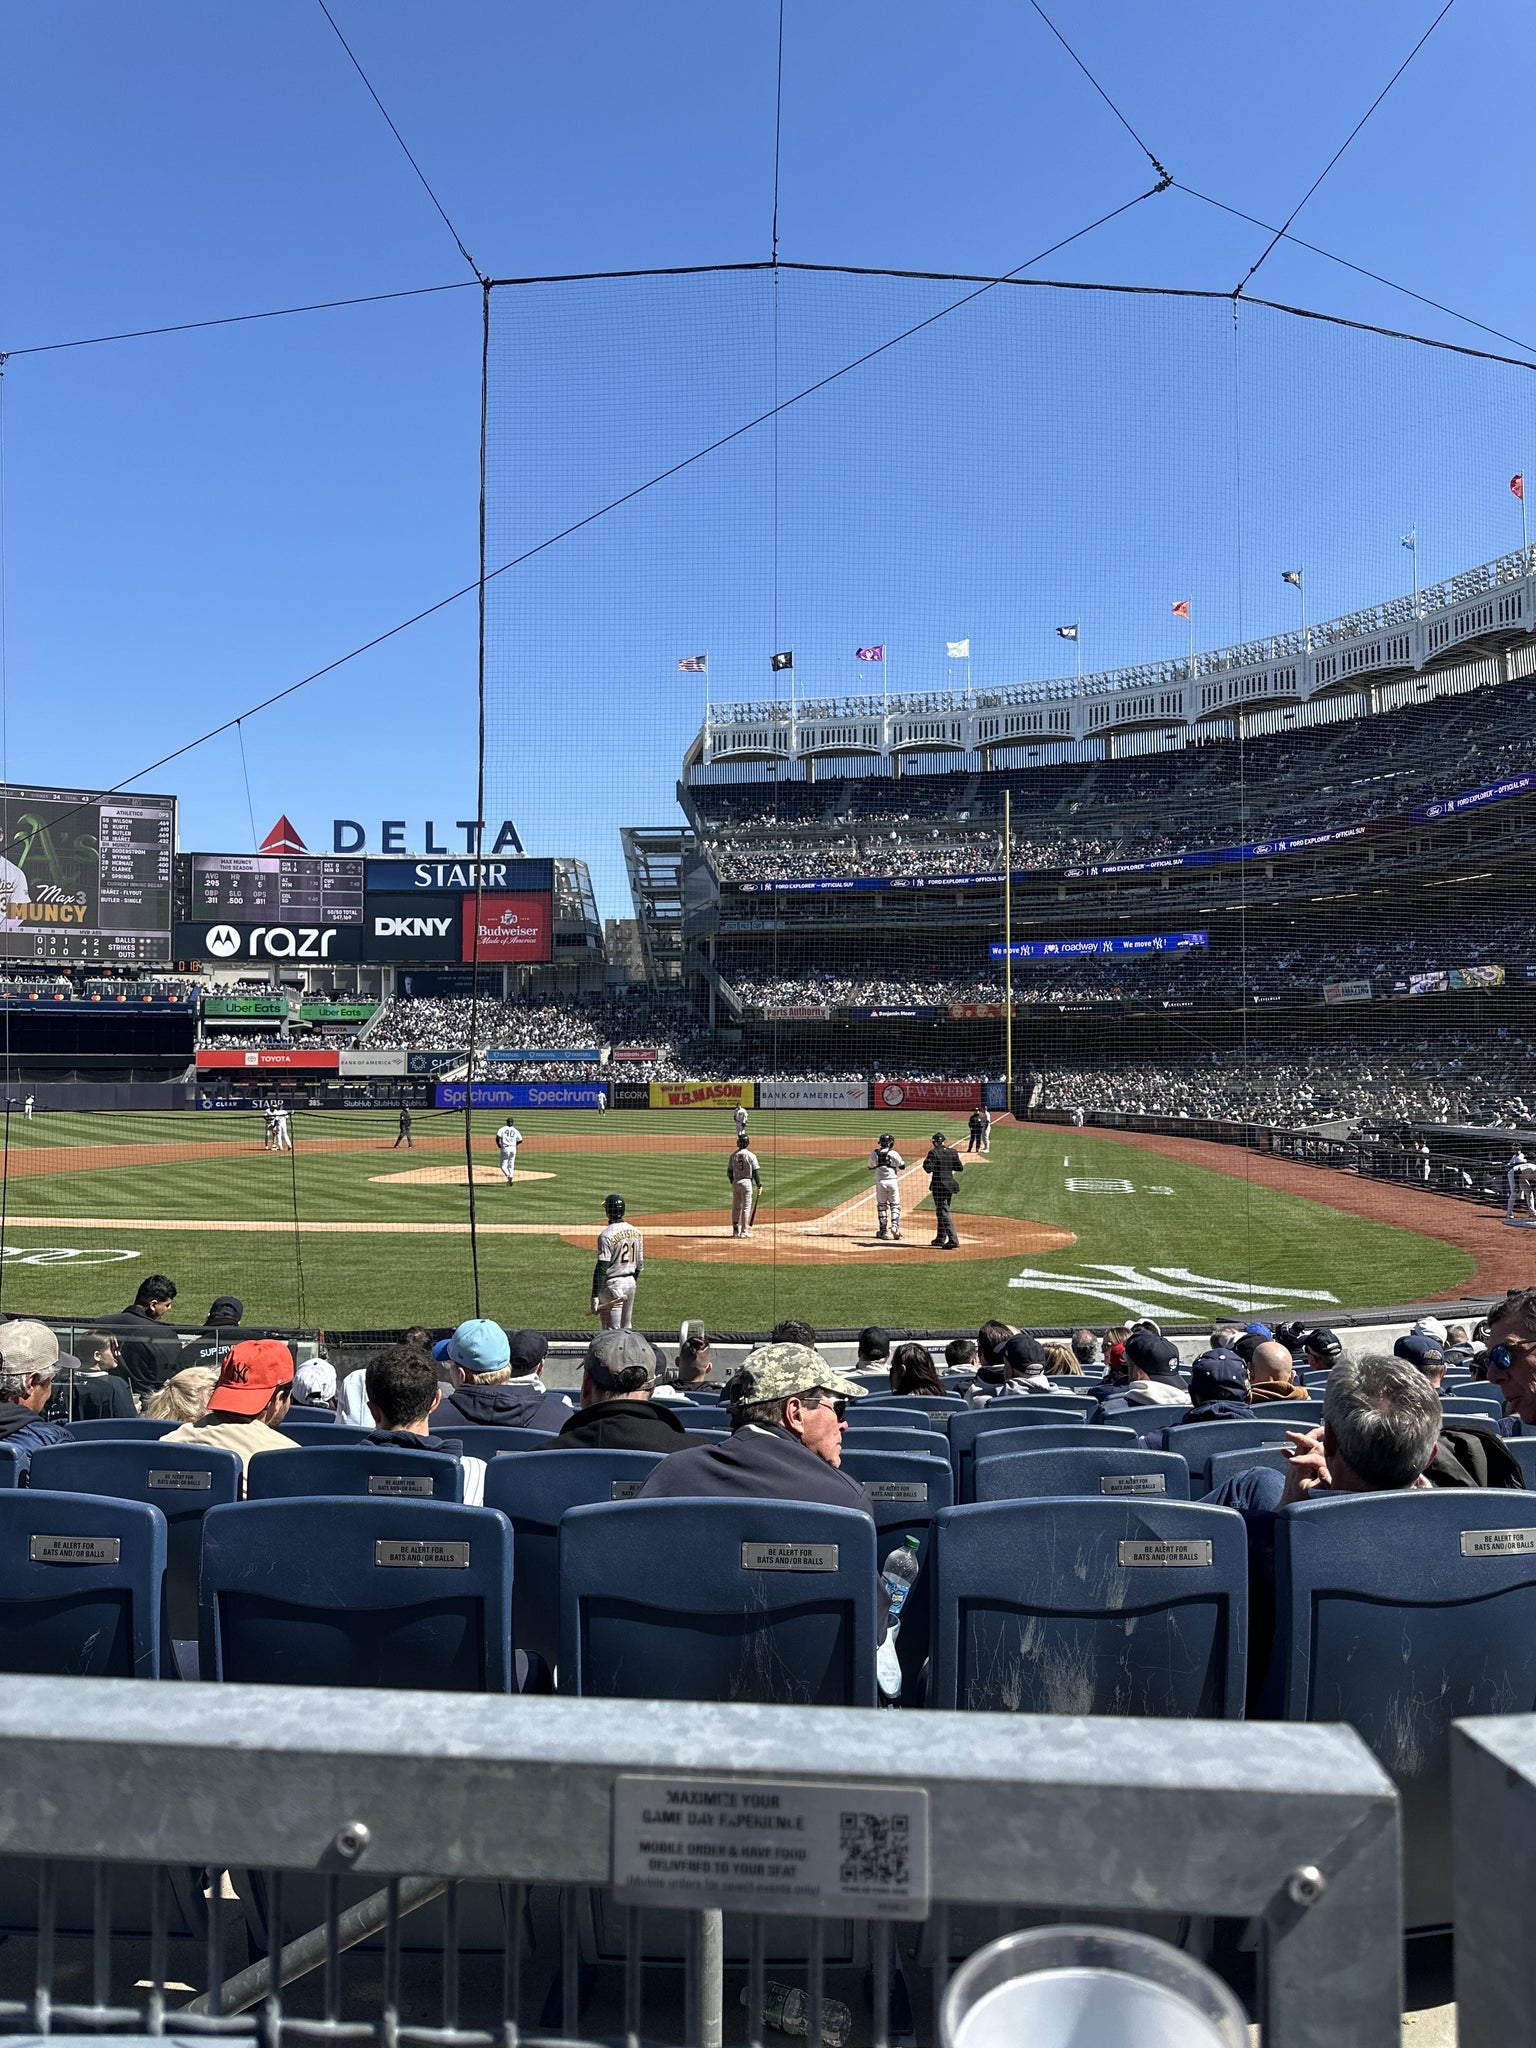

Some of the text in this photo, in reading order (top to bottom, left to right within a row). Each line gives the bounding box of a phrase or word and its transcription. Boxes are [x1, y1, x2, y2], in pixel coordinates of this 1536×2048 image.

[333, 820, 526, 854] DELTA
[414, 863, 508, 887] STARR
[36, 885, 87, 905] Max 3
[10, 902, 88, 922] MUNCY
[374, 917, 453, 936] DKNY
[479, 925, 538, 936] Budweiser
[249, 927, 337, 957] razr
[500, 937, 508, 945] of
[1061, 943, 1099, 953] roadway
[226, 1004, 252, 1013] Uber
[254, 1004, 281, 1013] Eats
[789, 1007, 825, 1017] Authority
[443, 1089, 596, 1106] Spectrum Spectrum
[906, 1086, 972, 1098] F.W. WEBB
[621, 1242, 635, 1264] 21
[200, 1345, 234, 1357] SUPERV
[1492, 1542, 1516, 1550] AND/OR
[666, 1790, 780, 1808] MAXIMIZE YOUR
[642, 1809, 804, 1831] GAME DAY EXPERIENCE
[639, 1841, 806, 1861] MOBILE ORDER & HAVE FOOD
[648, 1858, 797, 1878] DELIVERED TO YOUR SEAT
